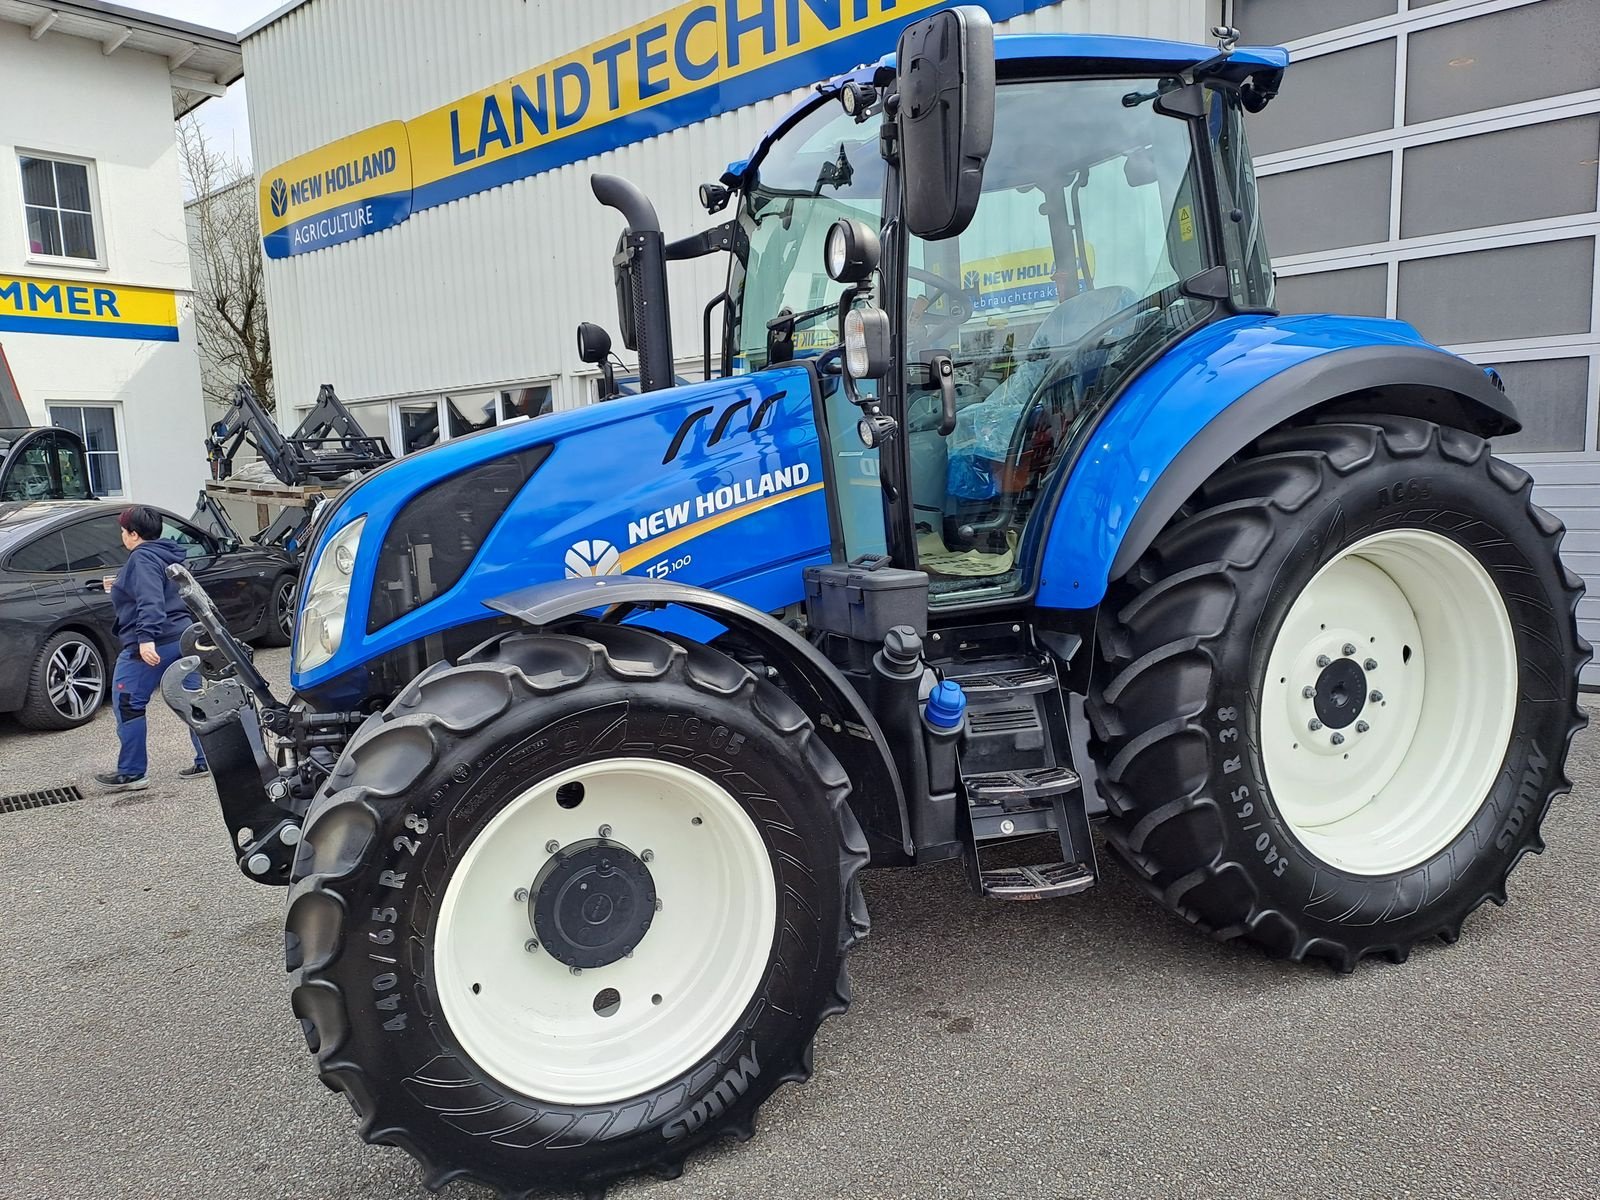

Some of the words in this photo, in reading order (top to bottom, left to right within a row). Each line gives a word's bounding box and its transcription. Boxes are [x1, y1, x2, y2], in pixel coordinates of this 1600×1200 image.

[450, 0, 896, 166] LANDTECHN
[290, 173, 322, 206] NEW
[325, 146, 396, 194] HOLLAND
[294, 205, 374, 246] AGRICULTURE
[0, 281, 120, 317] MMER
[983, 271, 1013, 286] NEW
[628, 499, 690, 545] NEW
[696, 462, 810, 518] HOLLAND
[646, 554, 692, 579] T5.100
[1217, 706, 1239, 744] 38
[1222, 754, 1242, 775] R
[393, 813, 429, 857] 28
[1230, 784, 1289, 878] 540/65
[378, 869, 408, 889] R
[368, 906, 409, 1031] 440/65
